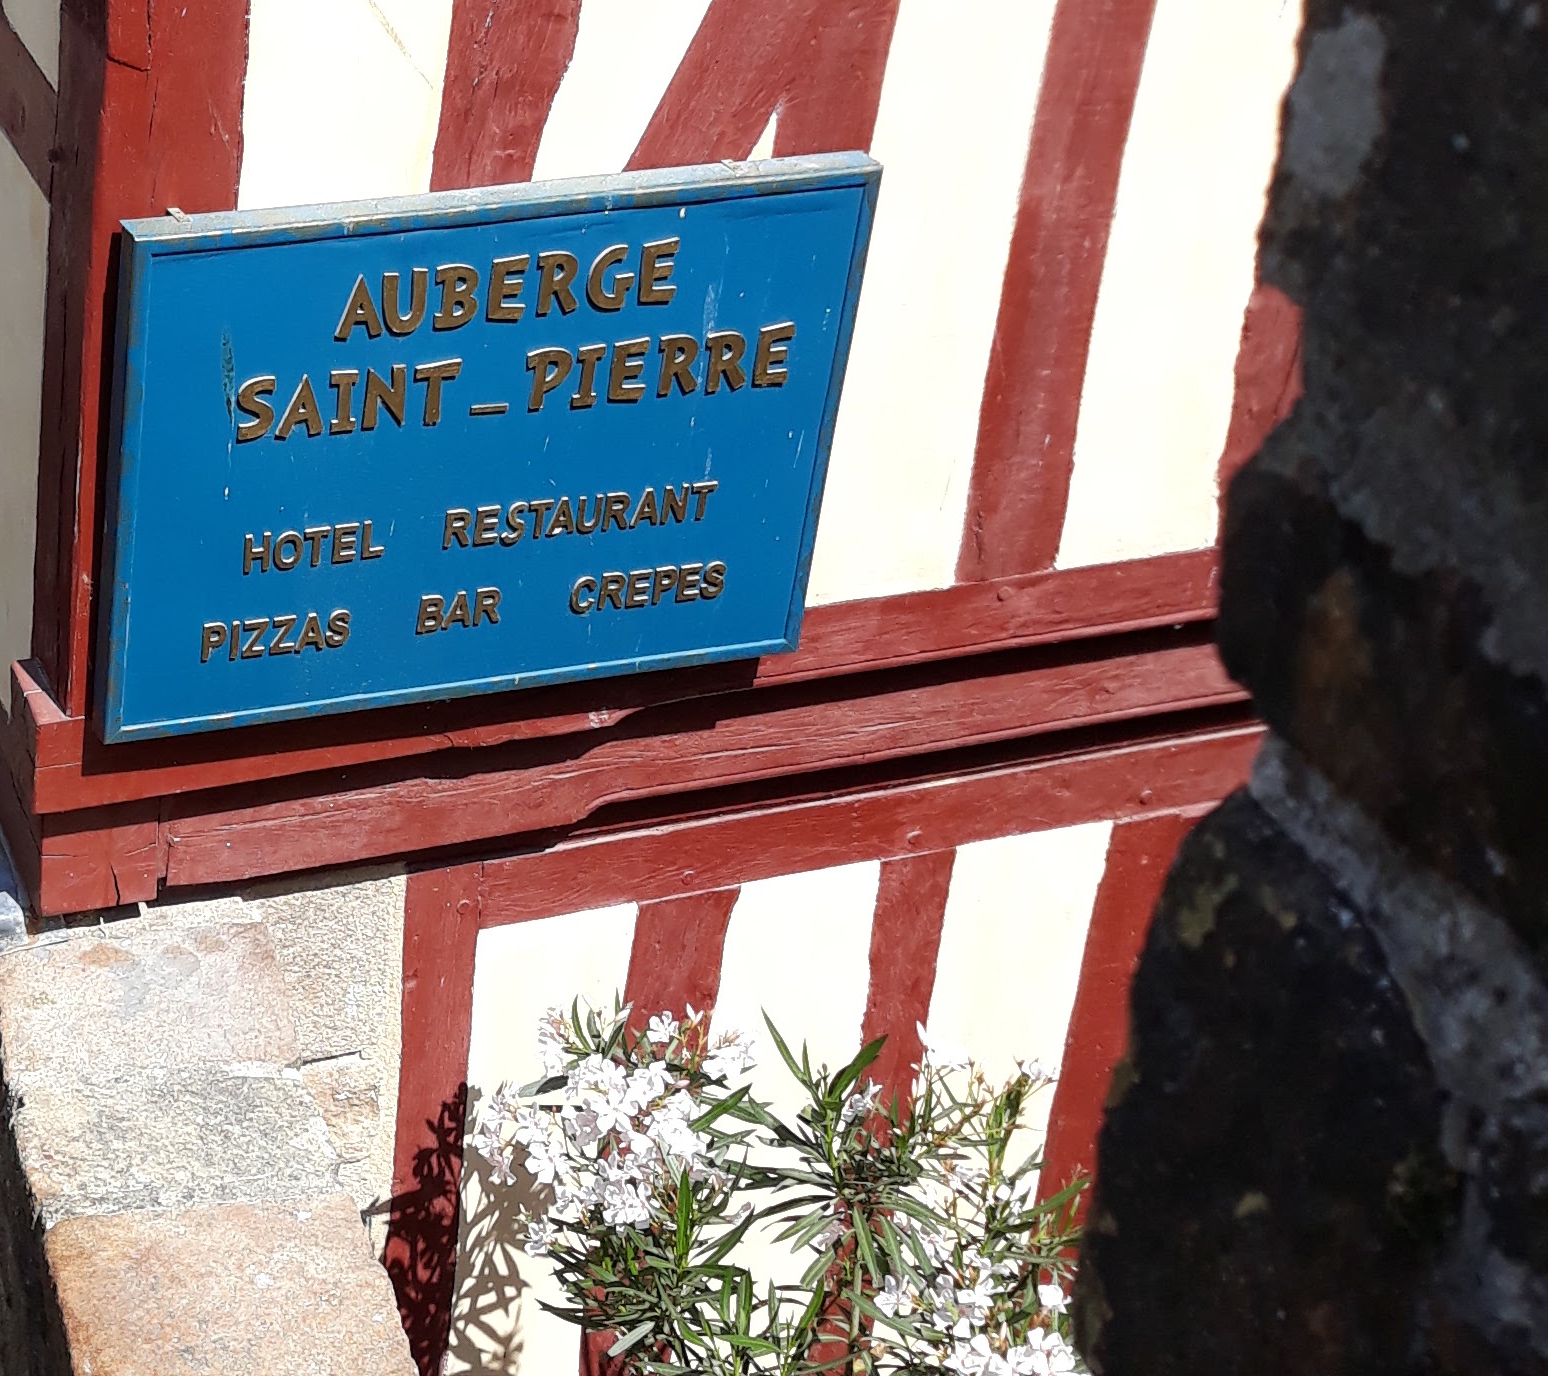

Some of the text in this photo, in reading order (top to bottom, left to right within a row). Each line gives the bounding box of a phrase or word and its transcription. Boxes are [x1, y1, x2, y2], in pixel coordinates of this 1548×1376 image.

[333, 236, 682, 343] AUBERGE
[235, 357, 464, 444] SAINT
[525, 321, 798, 415] PIERRE
[242, 481, 719, 576] HOTEL RESTAURANT
[199, 560, 728, 665] PIZZAS BAR CREPES
